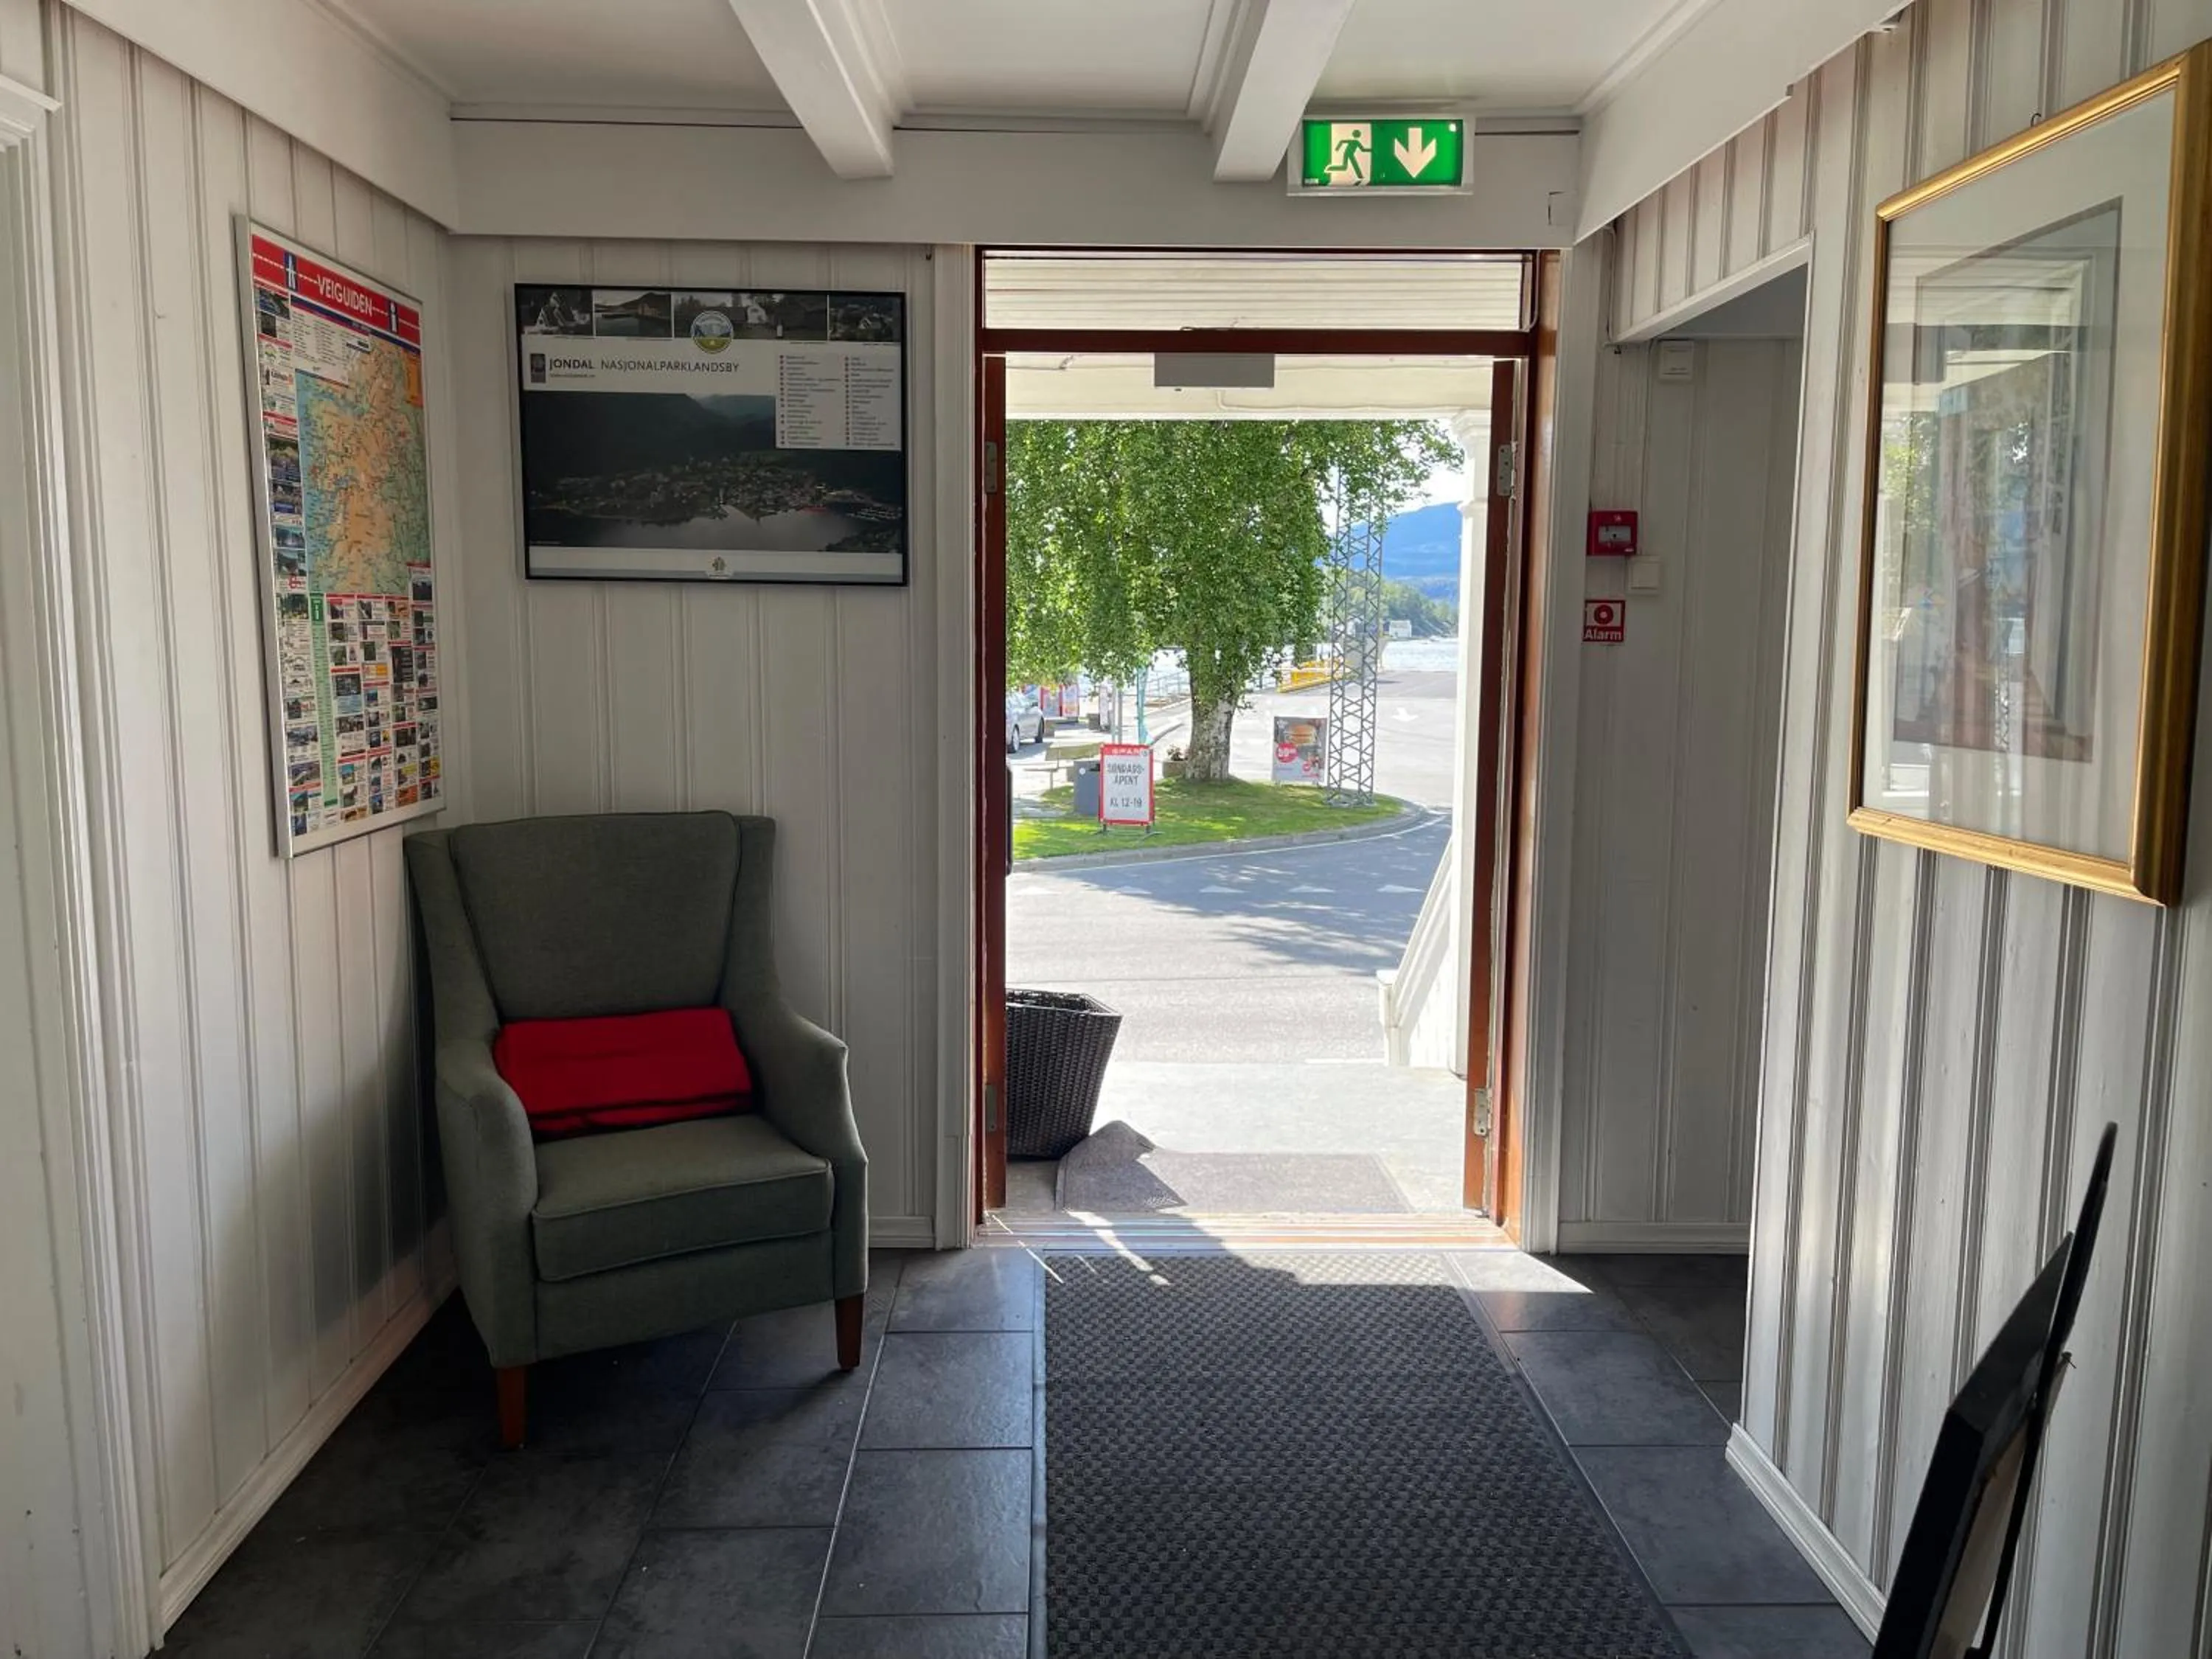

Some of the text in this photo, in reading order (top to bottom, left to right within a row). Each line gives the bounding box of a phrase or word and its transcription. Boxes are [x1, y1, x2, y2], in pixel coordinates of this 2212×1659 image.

[317, 273, 373, 317] VEIGUIDEN
[549, 358, 740, 373] JONDAL NASJONALPARKLANDSBY
[1585, 627, 1622, 641] Alarm
